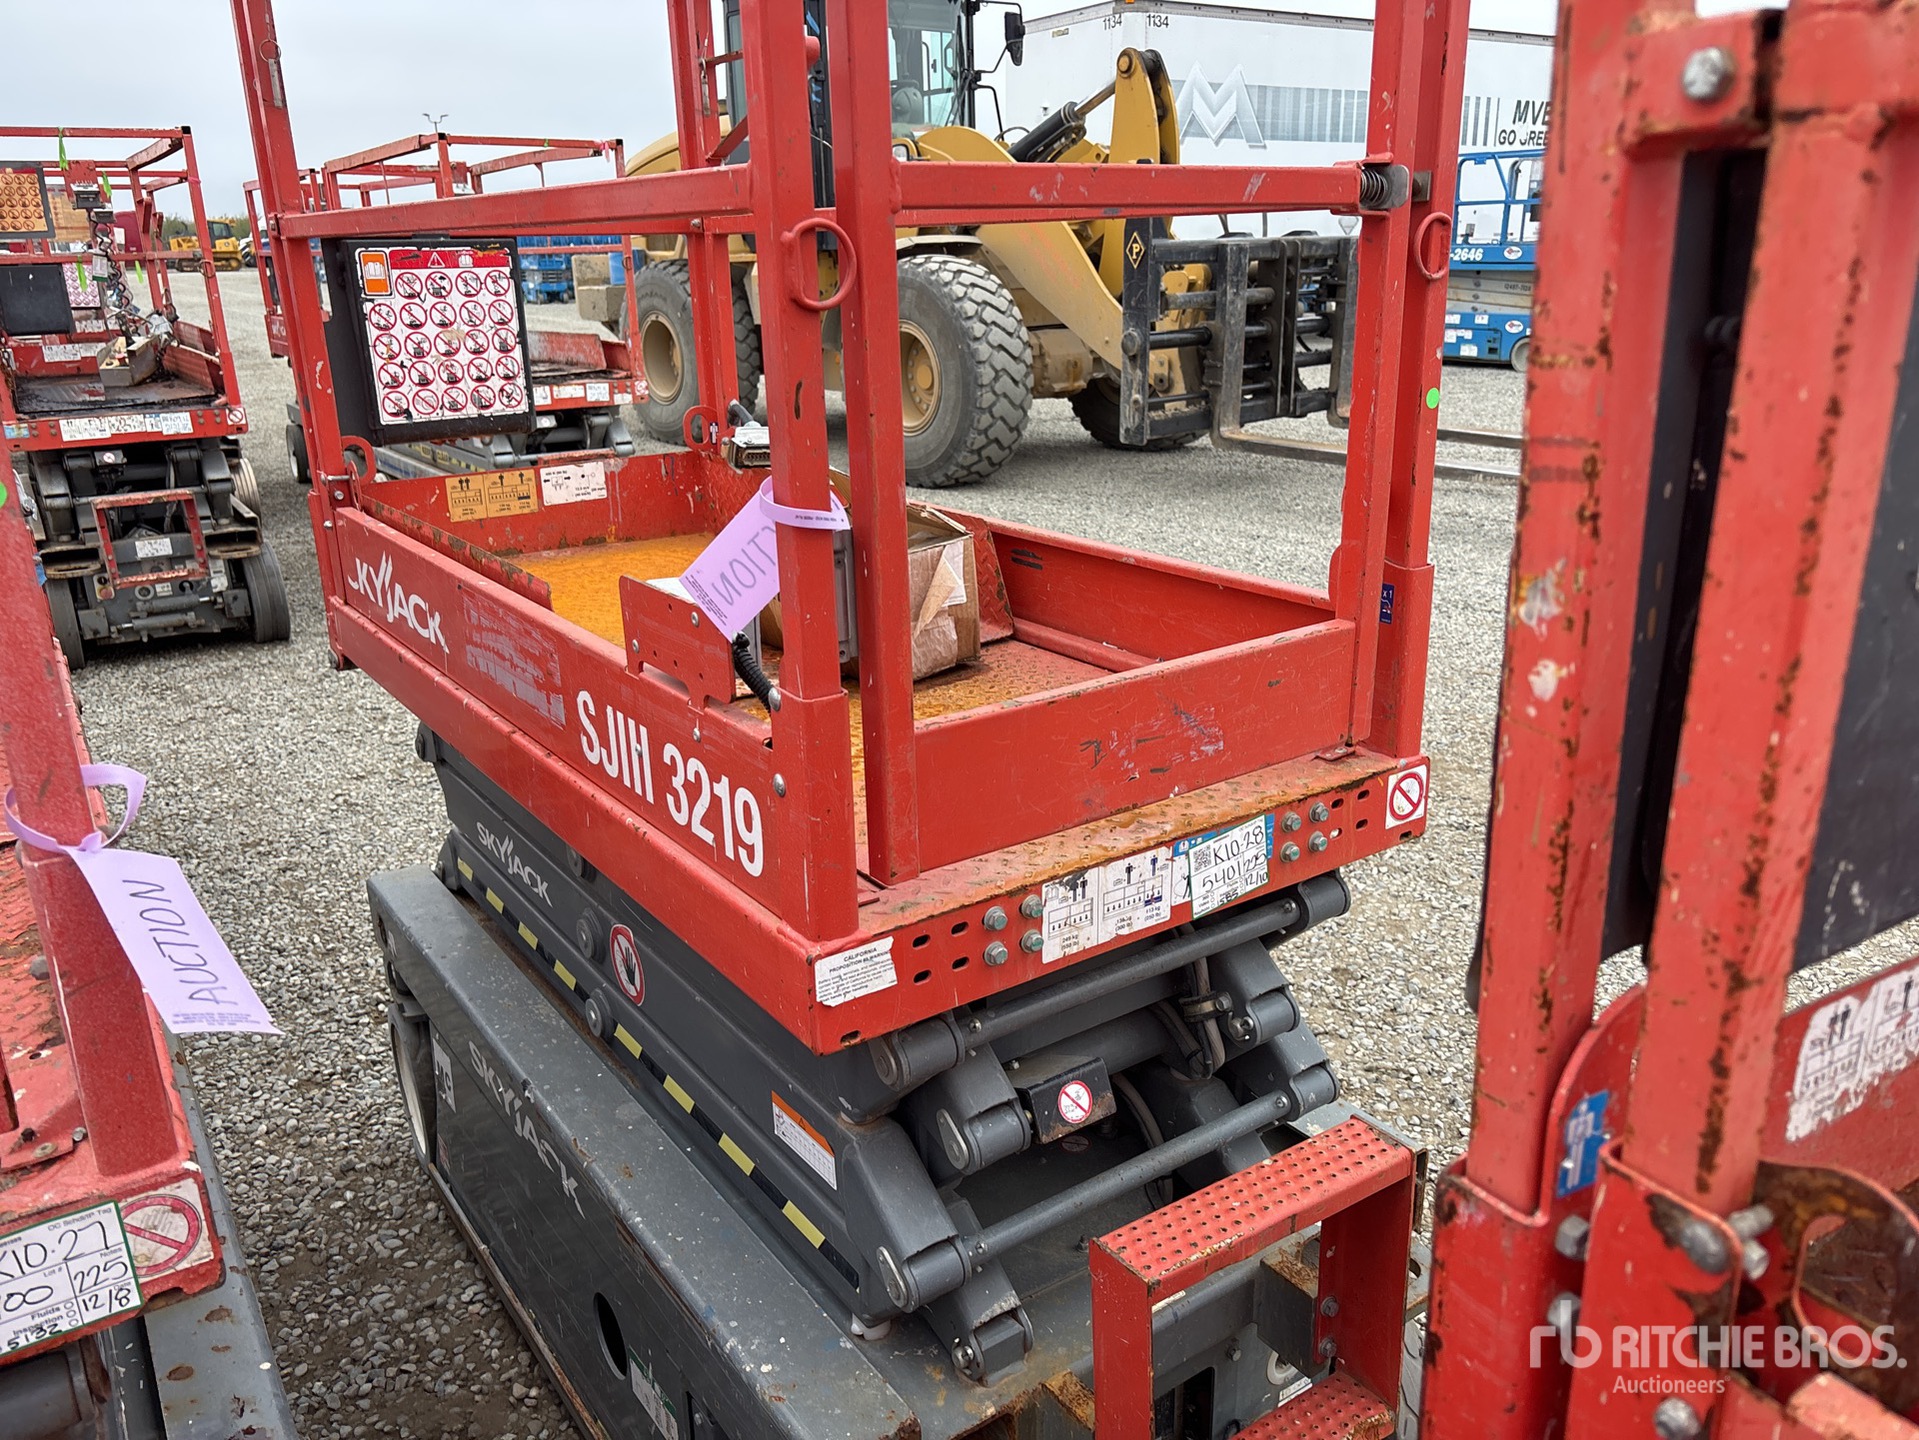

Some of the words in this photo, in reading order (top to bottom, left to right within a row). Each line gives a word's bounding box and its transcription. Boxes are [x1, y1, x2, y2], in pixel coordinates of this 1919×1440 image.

[1103, 13, 1122, 30] 1134
[1147, 13, 1169, 28] 1134
[1498, 129, 1517, 145] GO
[1132, 243, 1140, 259] P
[348, 551, 450, 655] KYJACK
[576, 690, 655, 805] SJIH
[662, 742, 764, 877] 3219
[1213, 825, 1264, 866] K10-28
[476, 821, 553, 908] SKYJACK
[1202, 861, 1241, 893] 5401
[1245, 871, 1269, 886] 12/10
[122, 879, 238, 1006] AUCTION
[844, 948, 877, 961] CALIFORNIA
[829, 959, 862, 973] PROPOSITION
[100, 1247, 122, 1258] Notes
[74, 1256, 128, 1293] 225
[82, 1287, 131, 1313] 12/8
[30, 1306, 61, 1320] Fluids
[13, 1315, 64, 1335] Inspection
